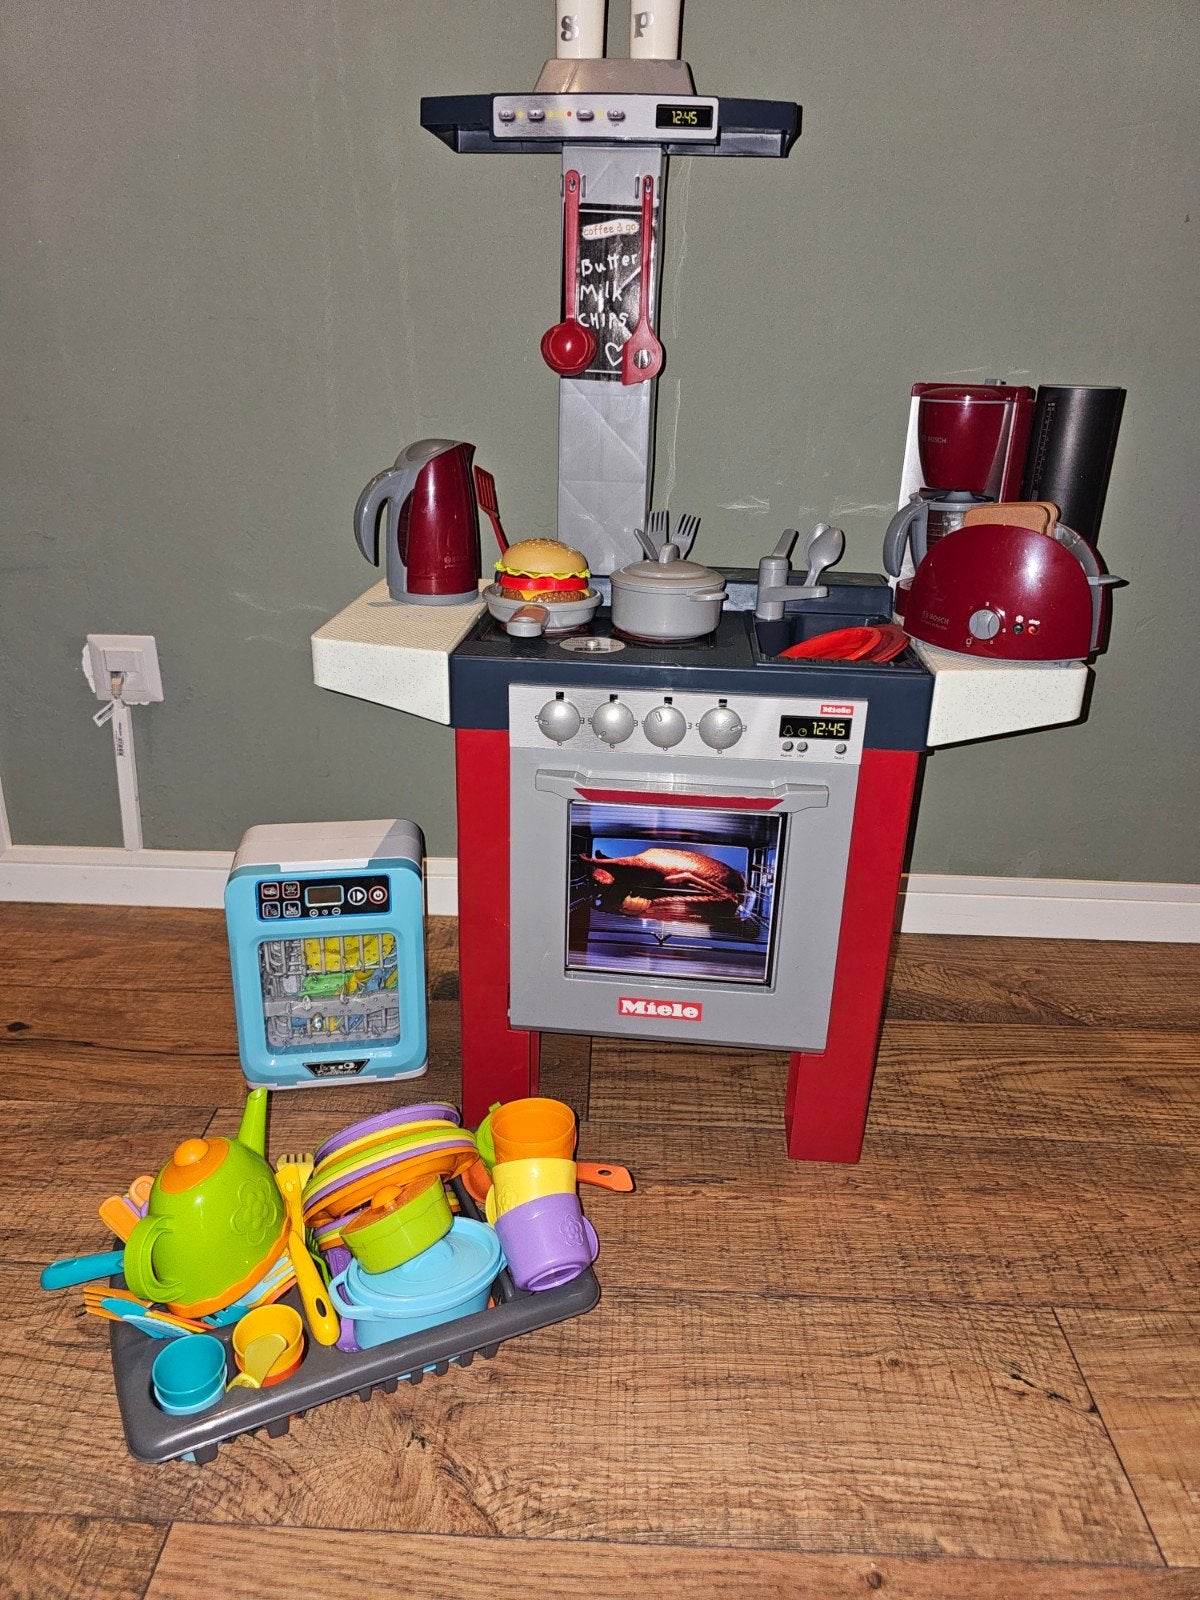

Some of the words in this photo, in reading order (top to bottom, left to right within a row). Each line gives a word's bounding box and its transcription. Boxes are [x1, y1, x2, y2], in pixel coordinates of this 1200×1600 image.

[561, 14, 579, 41] S
[634, 11, 654, 38] P
[672, 110, 698, 124] 12:45
[583, 224, 614, 236] coffee
[625, 224, 636, 233] go
[581, 253, 638, 277] Butter
[580, 280, 625, 304] Milk
[822, 706, 852, 714] Miele
[812, 721, 846, 736] 12:45
[621, 1000, 699, 1018] Miele
